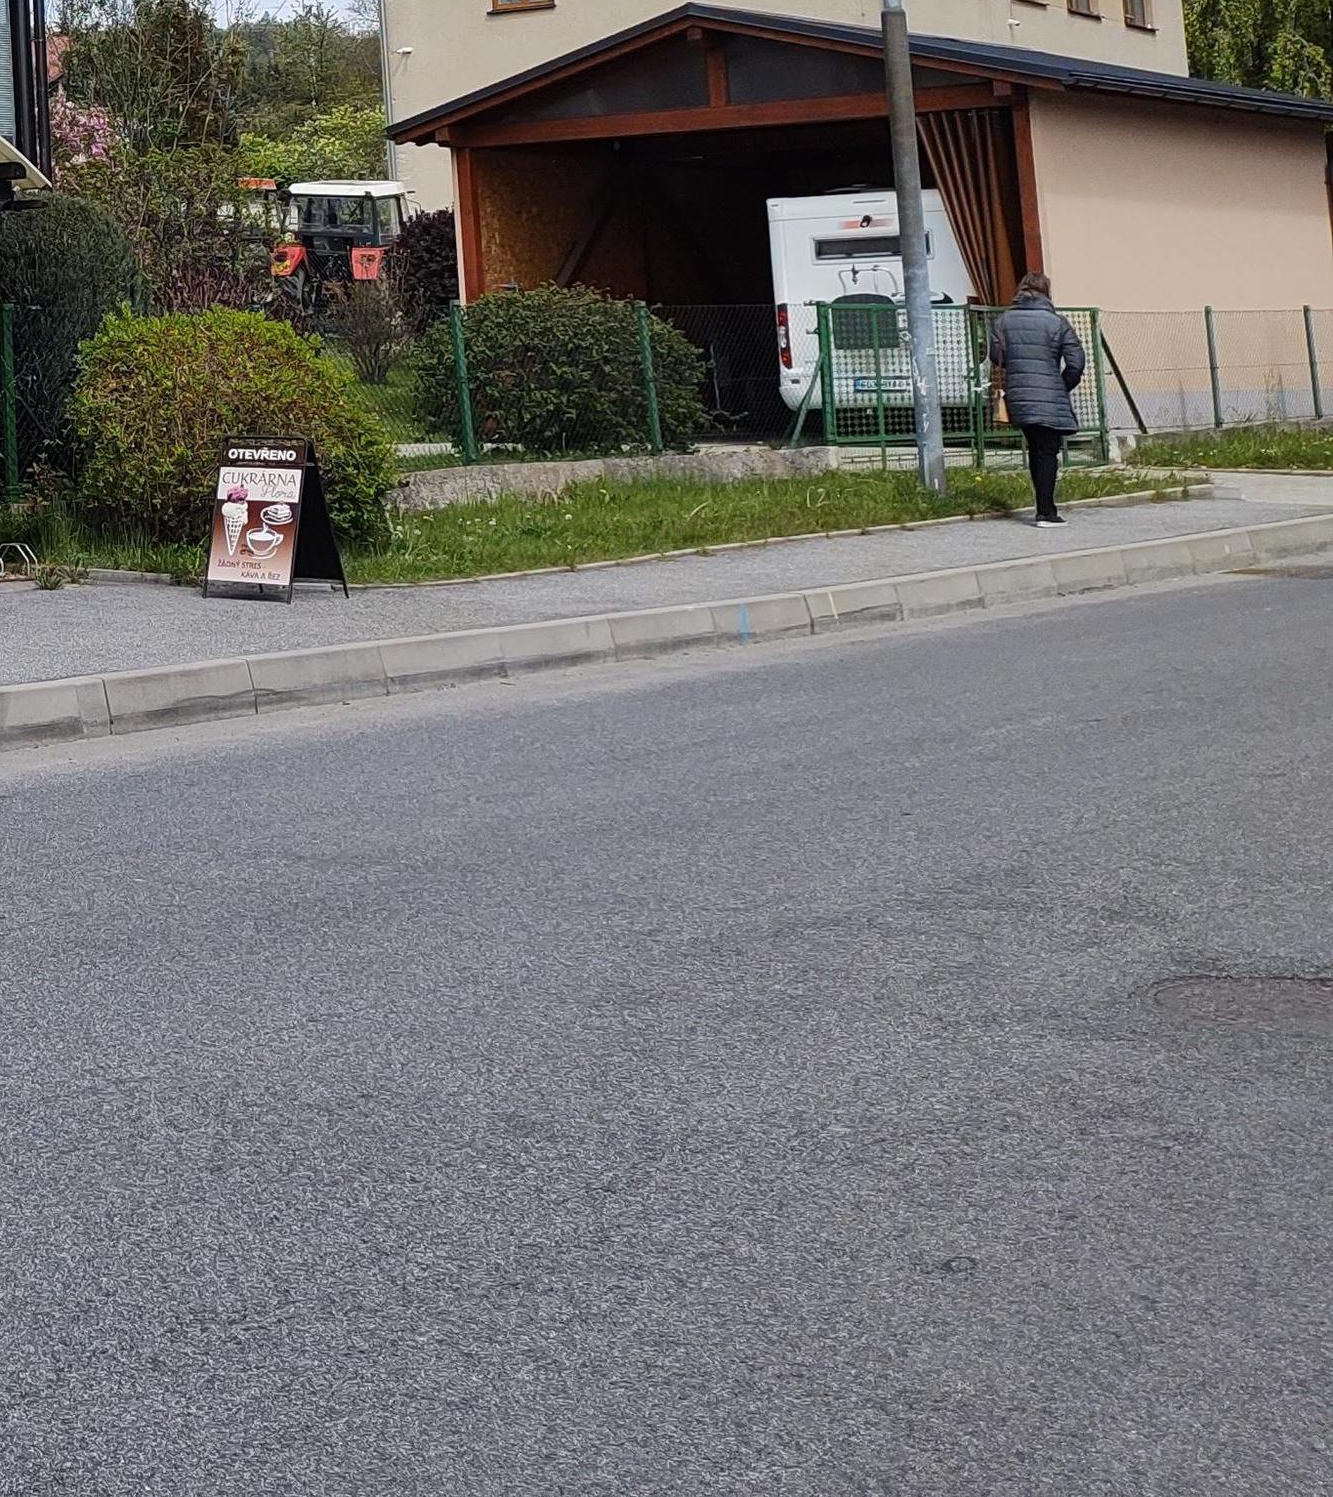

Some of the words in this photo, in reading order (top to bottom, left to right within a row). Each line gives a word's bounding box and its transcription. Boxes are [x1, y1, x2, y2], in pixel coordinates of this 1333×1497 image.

[228, 447, 297, 462] OTEVŘENO
[222, 470, 297, 487] CUKRÁRNA
[261, 485, 296, 499] Flora
